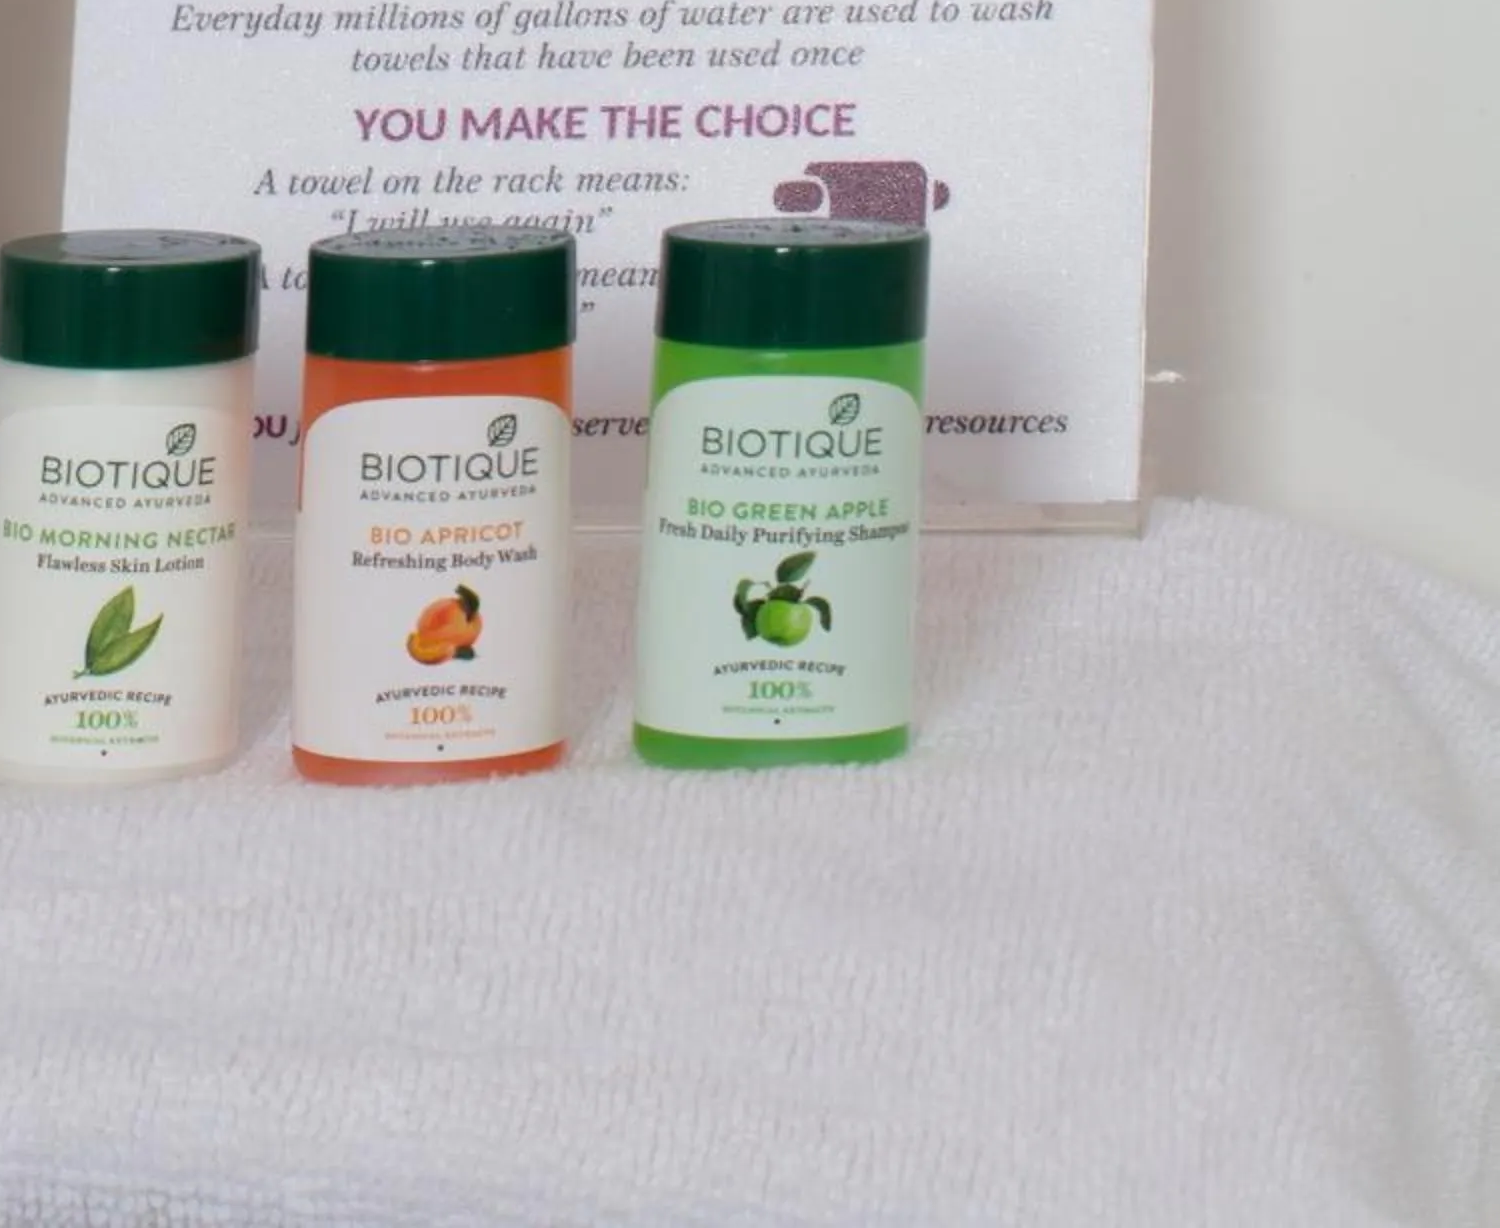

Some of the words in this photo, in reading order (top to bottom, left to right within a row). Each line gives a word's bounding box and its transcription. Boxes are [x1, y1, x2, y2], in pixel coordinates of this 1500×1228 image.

[171, 3, 323, 37] Everyday
[334, 2, 464, 30] millions
[474, 1, 510, 36] of
[514, 0, 628, 34] gallons
[639, 0, 676, 33] of
[679, 0, 774, 27] water
[782, 4, 835, 25] are
[929, 0, 960, 22] to
[351, 43, 450, 73] towels
[461, 42, 526, 71] that
[537, 41, 613, 69] have
[623, 40, 695, 68] been
[707, 39, 782, 67] used
[790, 45, 865, 66] once
[354, 107, 446, 142] YOU
[460, 106, 588, 141] MAKE
[601, 105, 683, 139] THE
[695, 103, 857, 138] CHOICE
[253, 169, 278, 195] A
[288, 167, 373, 195] towel
[382, 173, 420, 194] on
[432, 165, 483, 193] the
[492, 165, 563, 193] rack
[576, 168, 690, 193] means:
[368, 206, 431, 232] will
[924, 413, 1069, 435] resources
[701, 427, 883, 459] BIOTIQUE
[40, 455, 217, 489] BIOTIQUE
[361, 446, 540, 483] BIOTIQUE
[700, 463, 790, 479] ADVANCED
[799, 463, 880, 478] AYURVEDA
[38, 493, 127, 509] ADVANCED
[133, 493, 212, 510] AYURVEDA
[360, 488, 451, 503] ADVANCED
[458, 483, 537, 501] AYURVEDA
[688, 498, 725, 517] BIO
[732, 501, 817, 520] GREEN
[825, 498, 889, 520] APPLE
[3, 519, 34, 542] BIO
[39, 528, 159, 550] MORNING
[370, 526, 412, 545] BIO
[420, 520, 525, 545] APRICOT
[658, 518, 698, 539] Fresh
[701, 525, 748, 546] Daily
[752, 526, 845, 548] Purifying
[36, 553, 106, 573] Flawless
[110, 555, 151, 573] Skin
[155, 555, 205, 573] Lotion
[351, 551, 448, 571] Refreshing
[451, 551, 494, 570] Body
[498, 545, 538, 563] Wash
[714, 660, 793, 676] AYURVEDIC
[798, 661, 845, 676] RECIPE
[44, 690, 124, 707] AYURVEDIC
[127, 690, 173, 707] RECIPE
[375, 685, 456, 704] AYURVEDIC
[460, 685, 507, 699] RECIPE
[747, 681, 812, 701] 100%
[75, 710, 139, 730] 100%
[409, 705, 473, 725] 100%
